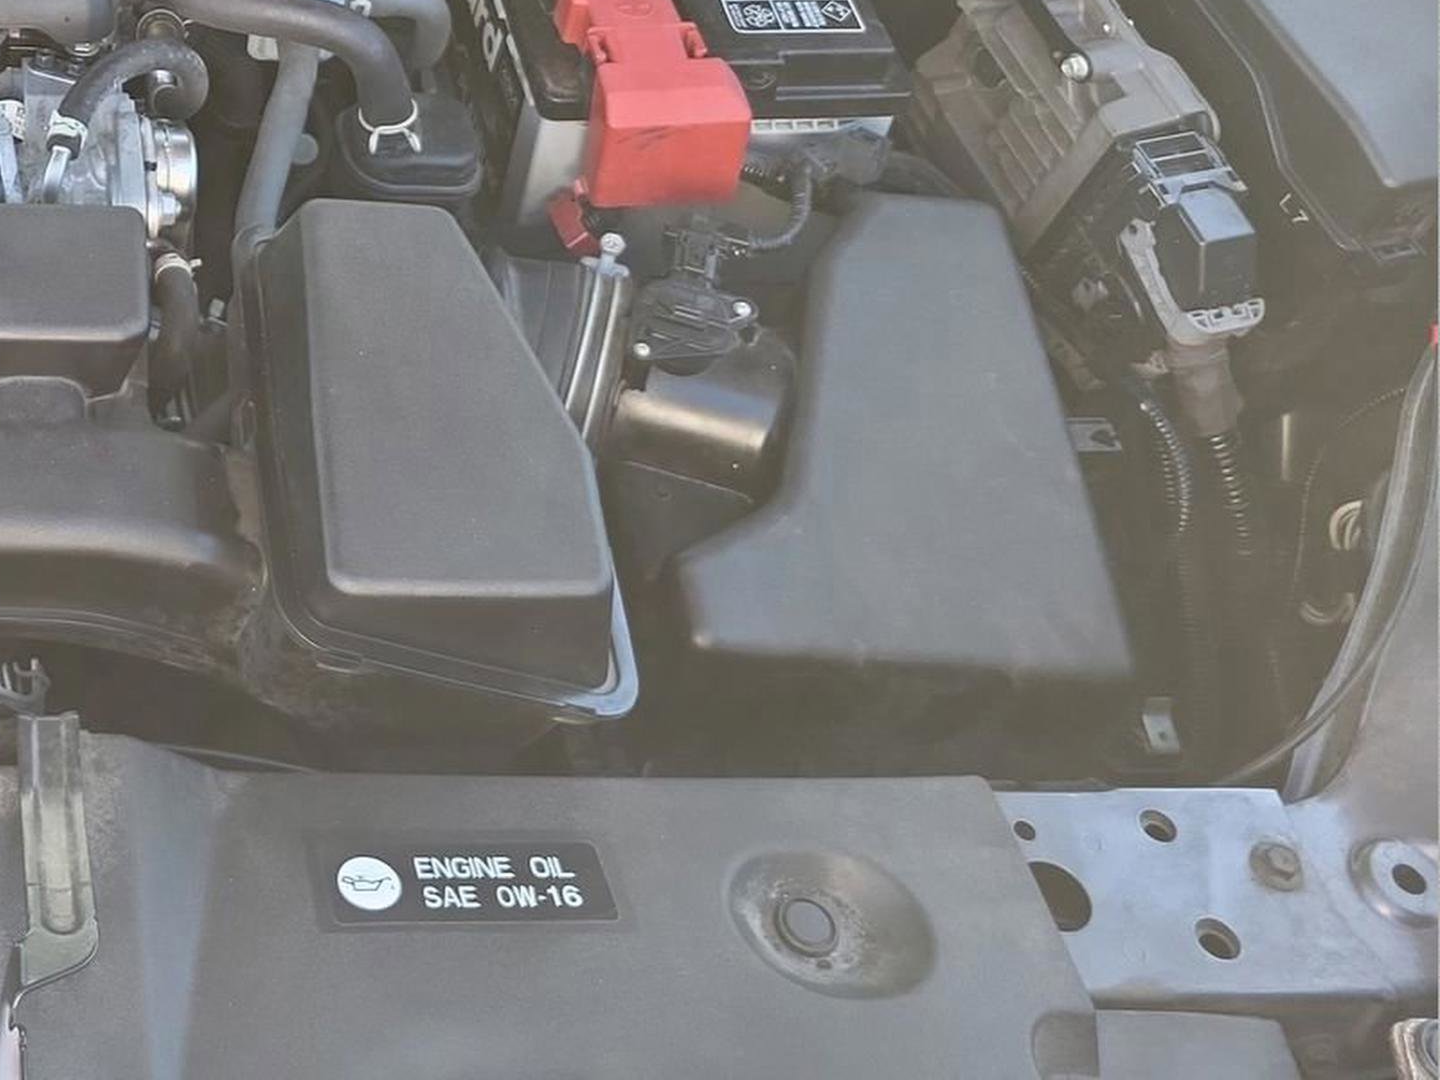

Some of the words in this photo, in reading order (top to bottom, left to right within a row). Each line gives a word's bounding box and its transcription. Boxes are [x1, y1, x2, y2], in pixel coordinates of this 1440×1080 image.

[413, 856, 516, 879] ENGINE
[529, 856, 575, 878] OIL
[422, 885, 482, 908] SAE
[495, 884, 584, 908] 0W-16
